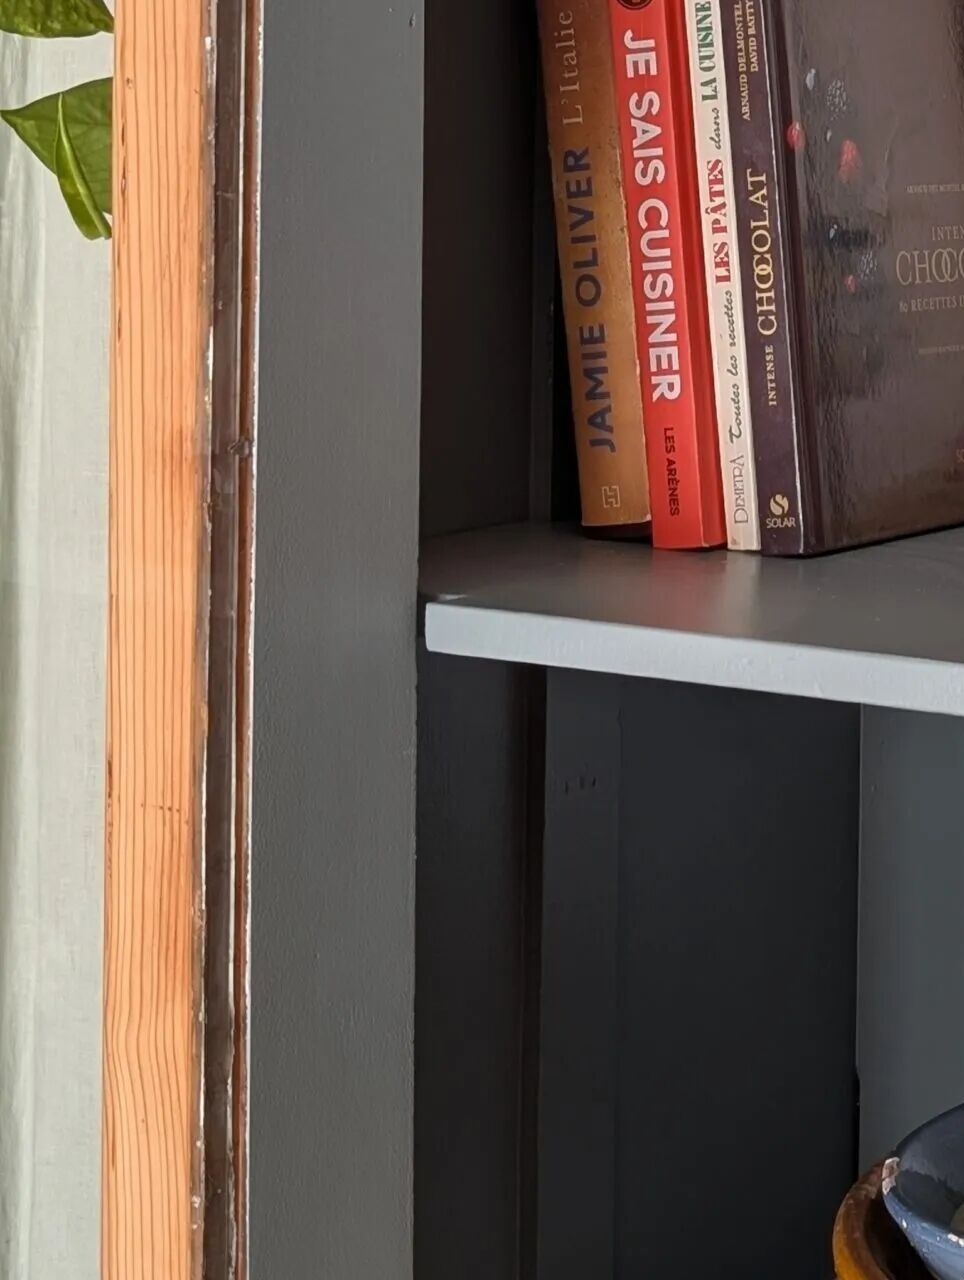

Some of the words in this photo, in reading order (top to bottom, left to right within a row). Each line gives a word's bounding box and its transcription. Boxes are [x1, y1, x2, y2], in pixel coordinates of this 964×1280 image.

[695, 1, 717, 73] CUISINE
[734, 0, 748, 72] DELMONTEL
[746, 0, 756, 34] BATTY
[624, 29, 657, 78] JE
[749, 36, 759, 72] DAVID
[701, 77, 719, 102] LA
[740, 73, 751, 120] ARNAUD
[628, 90, 666, 187] SAIS
[708, 107, 722, 150] dans
[705, 159, 729, 235] PÂTES
[563, 147, 602, 307] OLIVER
[746, 169, 777, 336] CHOCOLAT
[712, 242, 732, 285] LES
[637, 198, 681, 403] CUISINER
[911, 295, 957, 312] RECETTES
[579, 323, 616, 453] JAMIE
[727, 355, 739, 376] les
[764, 345, 777, 406] INTENSE
[728, 382, 743, 444] Toutes
[664, 427, 676, 453] LES
[666, 458, 680, 516] ARÈNES
[766, 517, 796, 529] SOLAR
